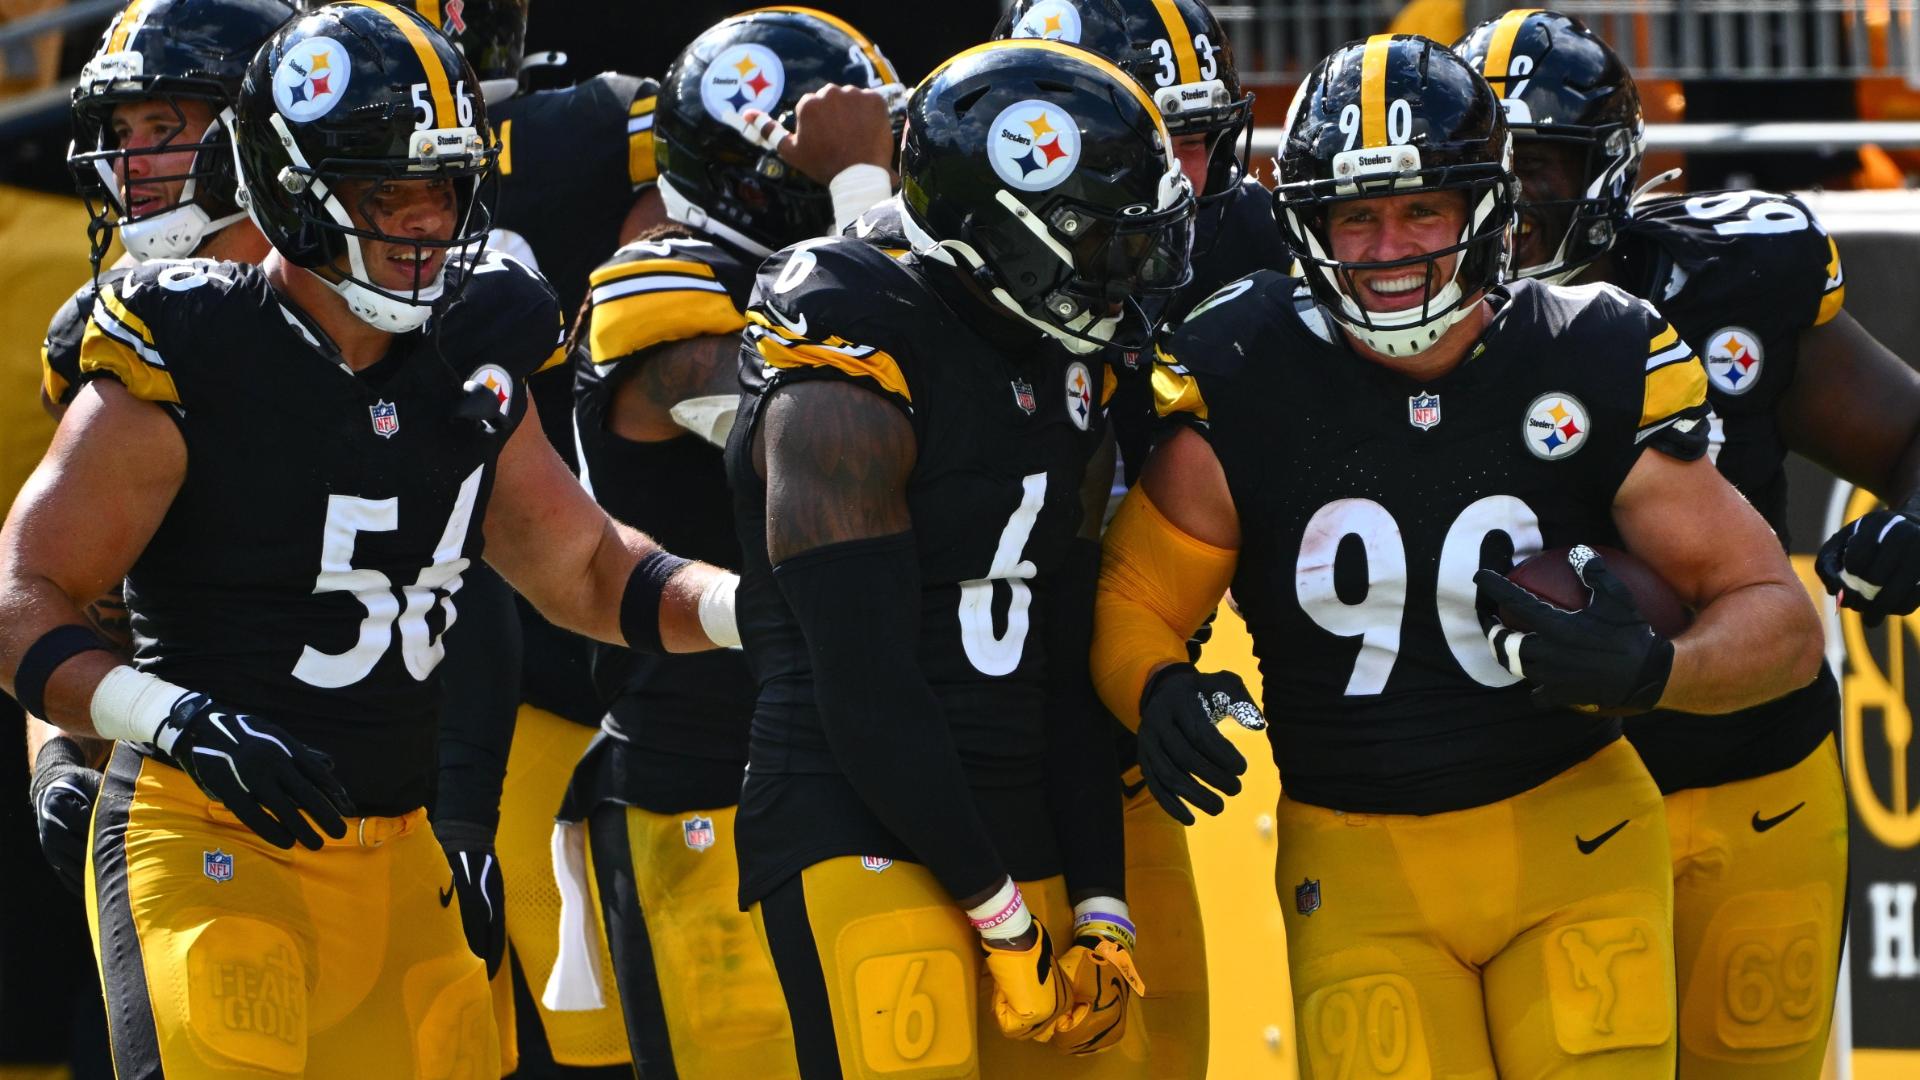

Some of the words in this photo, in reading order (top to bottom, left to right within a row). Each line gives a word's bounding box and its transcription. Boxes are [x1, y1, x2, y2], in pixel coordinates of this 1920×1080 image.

[289, 58, 308, 77] Steelers
[712, 76, 739, 86] Steelers
[1181, 88, 1209, 102] Steelers
[437, 134, 463, 147] Steelers
[1001, 129, 1032, 146] Steelers
[1358, 153, 1393, 167] Steelers
[1708, 355, 1733, 365] Steelers
[1415, 408, 1437, 423] NFL
[376, 416, 397, 432] NFL
[1529, 417, 1556, 431] Steelers
[291, 462, 485, 688] 56
[958, 471, 1048, 677] 6
[208, 863, 230, 877] NFL
[1868, 882, 1920, 979] H
[1725, 936, 1821, 1025] 69
[211, 962, 300, 1018] FEAR
[893, 958, 936, 1061] 6
[223, 998, 299, 1046] GOD
